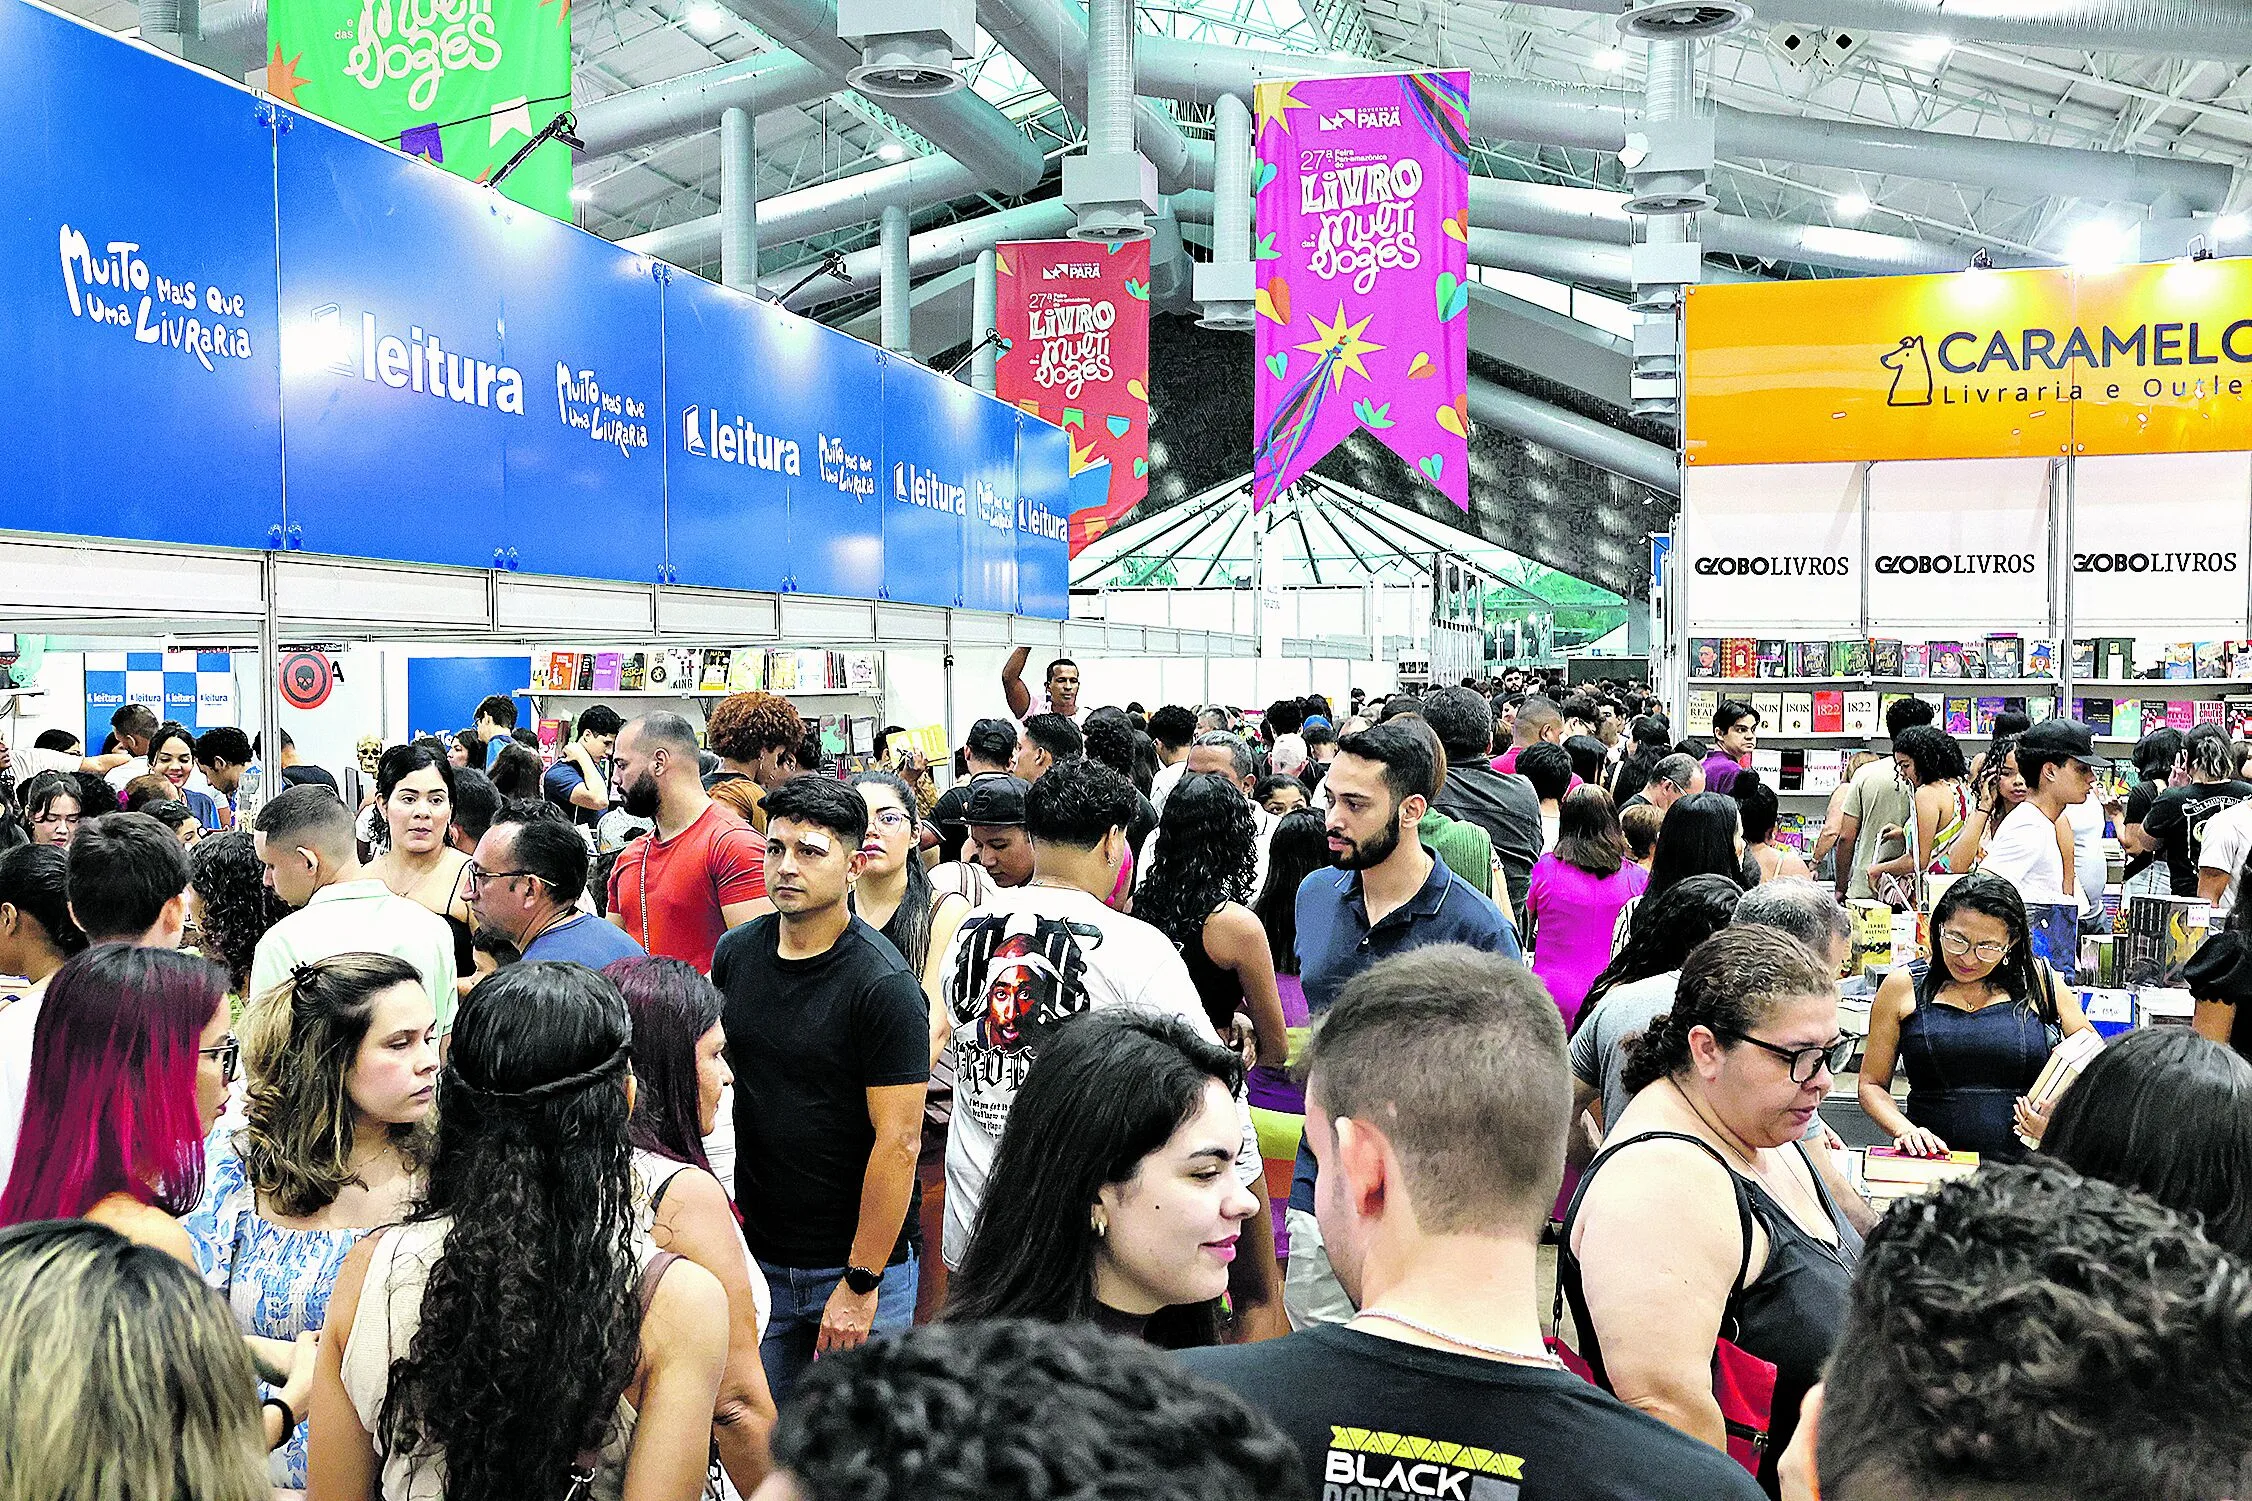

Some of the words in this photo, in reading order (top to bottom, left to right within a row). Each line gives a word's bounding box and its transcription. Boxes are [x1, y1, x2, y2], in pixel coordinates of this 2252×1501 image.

[333, 29, 354, 41] das
[362, 311, 526, 417] leitura
[1944, 380, 2084, 405] Livraria
[2106, 382, 2121, 400] e
[2143, 374, 2252, 400] Outle
[709, 408, 801, 477] leitura
[909, 463, 967, 517] leitura
[1027, 498, 1069, 543] leitura
[93, 692, 124, 703] leitura
[135, 693, 162, 703] leitura
[171, 692, 196, 703] leitura
[204, 693, 228, 702] leitura
[1817, 703, 1841, 716] 1822
[1848, 702, 1871, 713] 1822
[1324, 1449, 1470, 1501] BLACK
